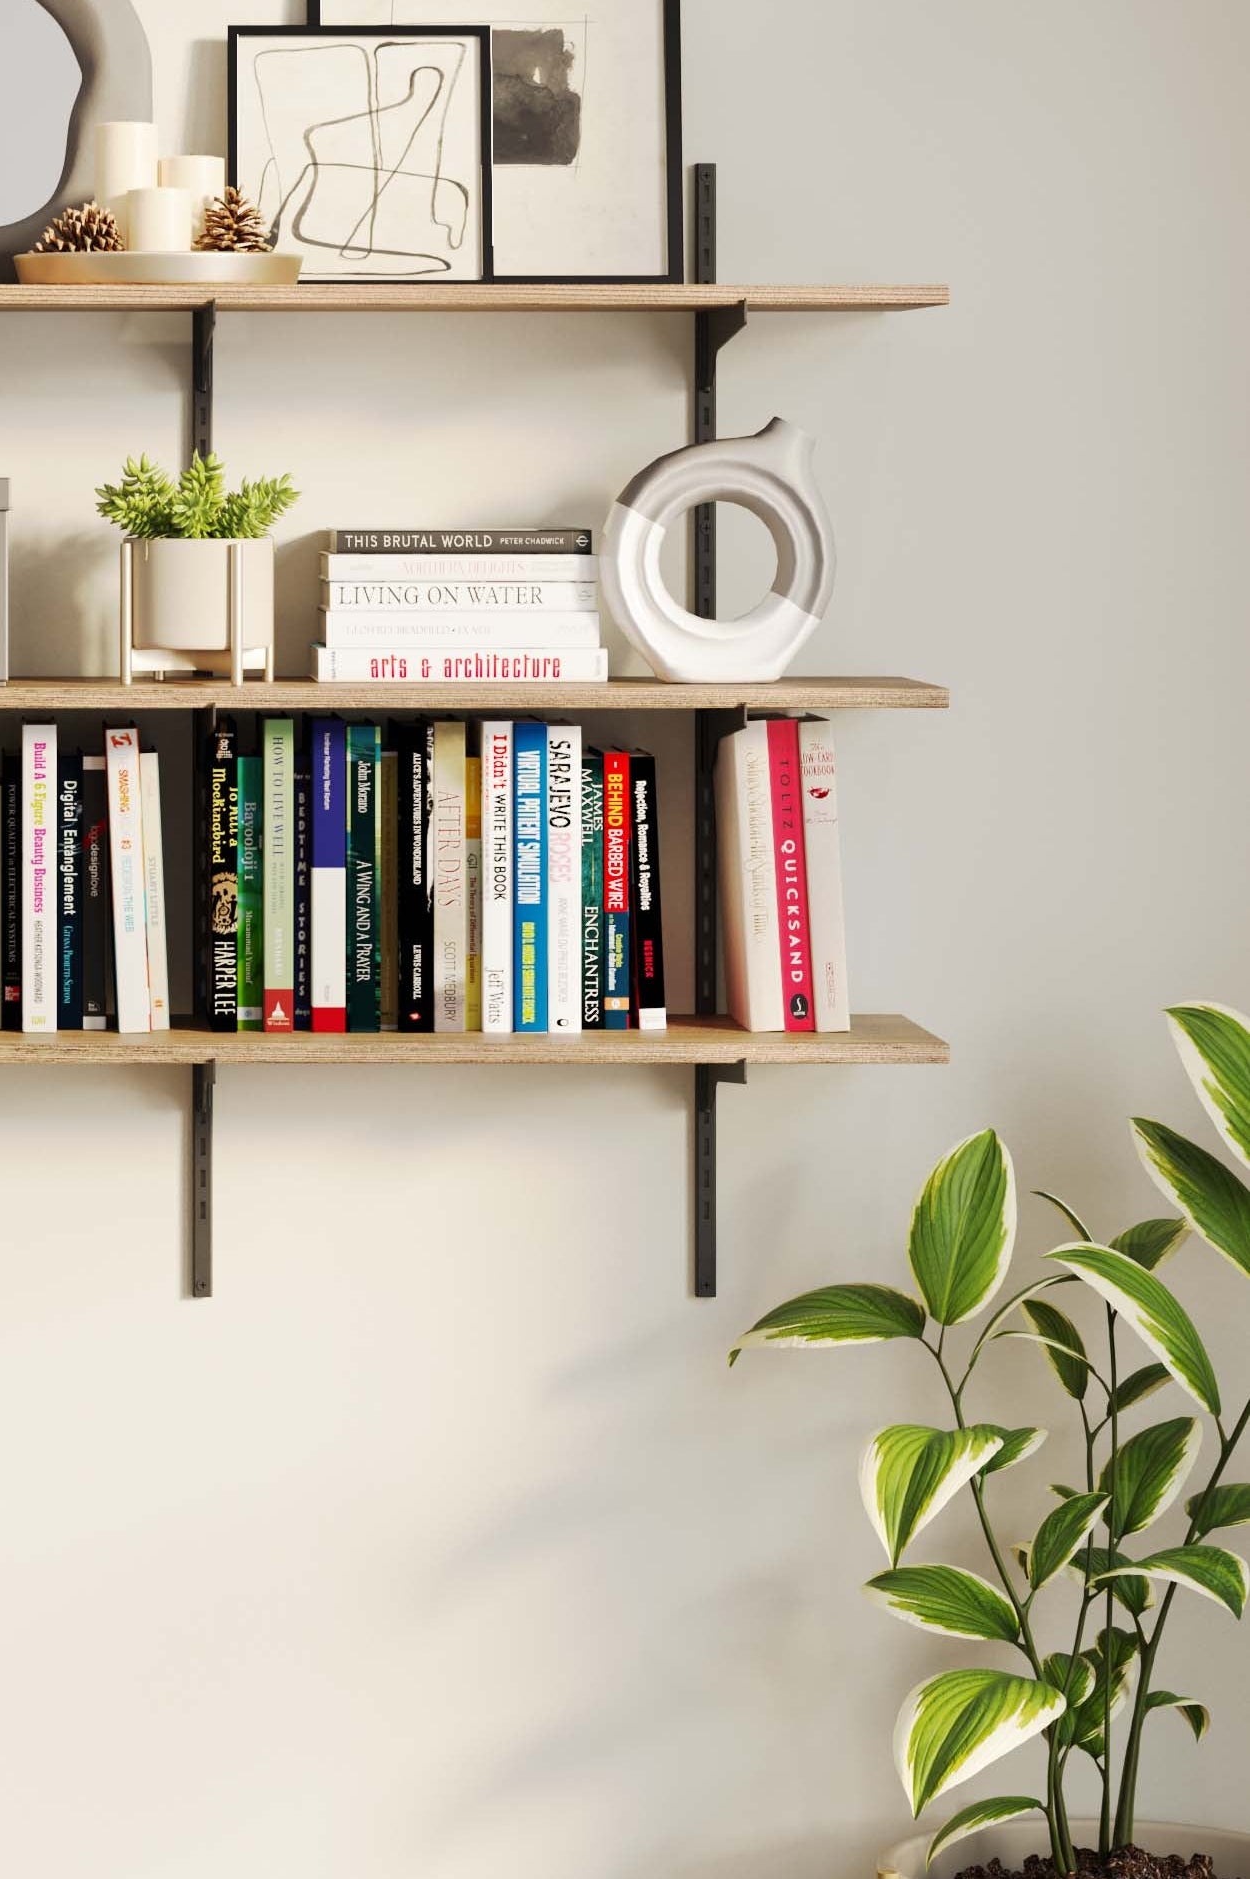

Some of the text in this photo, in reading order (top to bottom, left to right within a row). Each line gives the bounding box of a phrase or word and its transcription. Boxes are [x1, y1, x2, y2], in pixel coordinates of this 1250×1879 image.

[345, 535, 493, 548] THIS BRUTAL WORLD
[500, 537, 565, 546] PETER CHADWICK
[338, 586, 543, 605] LIVING ON WATER
[370, 653, 561, 678] arts & architecture
[33, 742, 46, 769] Build
[272, 736, 283, 766] HOW
[494, 745, 507, 789] Didn't
[33, 772, 46, 780] A
[272, 771, 283, 788] TO
[357, 760, 372, 814] John Morano
[517, 750, 541, 796] VIRTUAL
[550, 740, 571, 828] SARAJEVO
[8, 784, 17, 815] POWER
[31, 792, 46, 825] Figure
[212, 768, 226, 863] Mockingbird
[272, 792, 283, 822] LIVE
[413, 752, 422, 885] ALICE'S ADVENTURES IN WONDERLAND
[437, 791, 461, 851] AFTER
[494, 794, 507, 832] WRITE
[517, 798, 541, 840] PATIENT
[582, 768, 593, 847] MAXWELL
[592, 783, 603, 831] JAMES
[634, 780, 648, 823] Rejection,
[7, 817, 17, 857] QUALITY
[31, 828, 46, 865] Beauty
[61, 780, 78, 915] Digital Entanglement
[272, 824, 283, 857] WELL
[494, 836, 507, 863] THIS
[550, 832, 571, 883] ROSES
[608, 773, 623, 909] BEHIND BARBED WIRE
[637, 824, 649, 863] Romance
[8, 867, 17, 922] ELECTRICAL
[33, 868, 46, 913] Business
[297, 792, 307, 996] BEDTIME STORIES
[494, 866, 507, 901] BOOK
[517, 842, 541, 905] SIMULATION
[638, 872, 652, 912] Royalties
[356, 860, 372, 982] A WING AND A PRAYER
[782, 839, 804, 984] QUICKSAND
[8, 923, 17, 963] SYSTEMS
[585, 906, 599, 1022] ENCHANTRESS
[644, 940, 653, 978] RESNICK
[214, 941, 236, 1015] HARPER LEE
[413, 944, 422, 1000] LEWIS CARROLL
[444, 941, 456, 1022] SCOTT MEDBURY
[485, 969, 505, 1024] Jeff Watts
